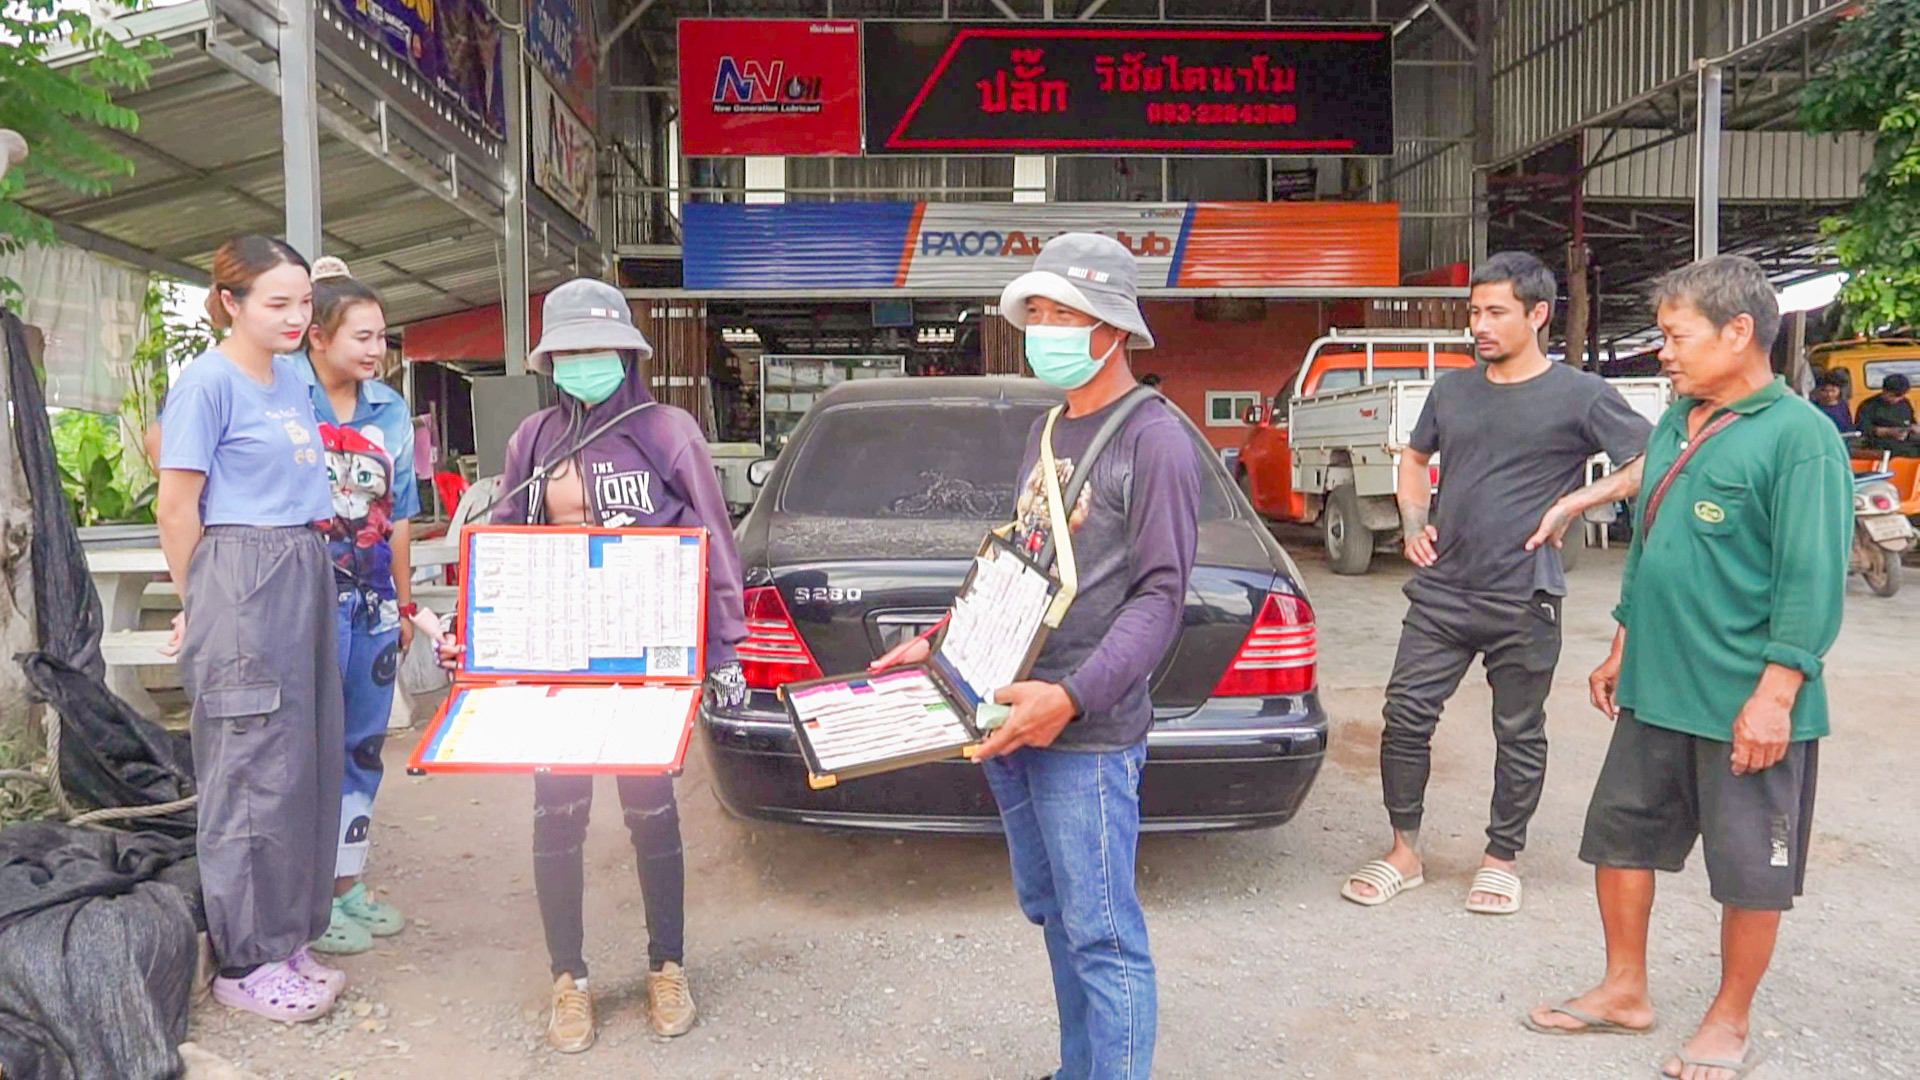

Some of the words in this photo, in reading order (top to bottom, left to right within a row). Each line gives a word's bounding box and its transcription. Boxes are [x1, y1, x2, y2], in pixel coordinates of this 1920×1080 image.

[976, 47, 1067, 112] ปลั๊ก
[733, 104, 778, 112] Generation
[780, 104, 820, 112] Lubricant
[794, 586, 862, 604] S280
